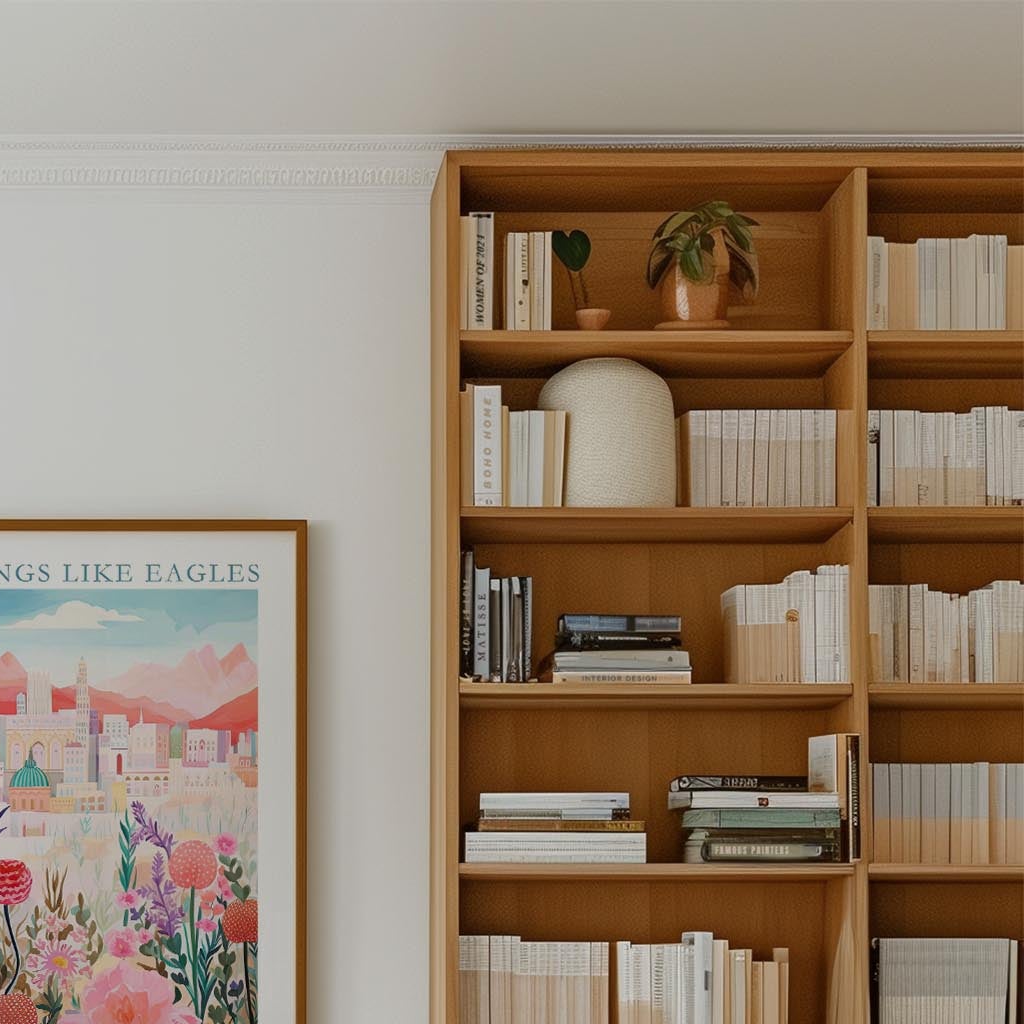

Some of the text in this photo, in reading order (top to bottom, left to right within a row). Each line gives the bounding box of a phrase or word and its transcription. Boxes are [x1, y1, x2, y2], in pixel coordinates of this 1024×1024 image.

[476, 260, 485, 276] OF
[475, 279, 485, 325] WOMEN
[483, 398, 492, 439] HOME
[483, 447, 492, 489] BOHO
[63, 564, 132, 583] LIKE
[146, 564, 260, 583] EAGLES
[477, 593, 486, 661] MATISSE
[714, 845, 789, 855] FAMOUS PAINTERS
